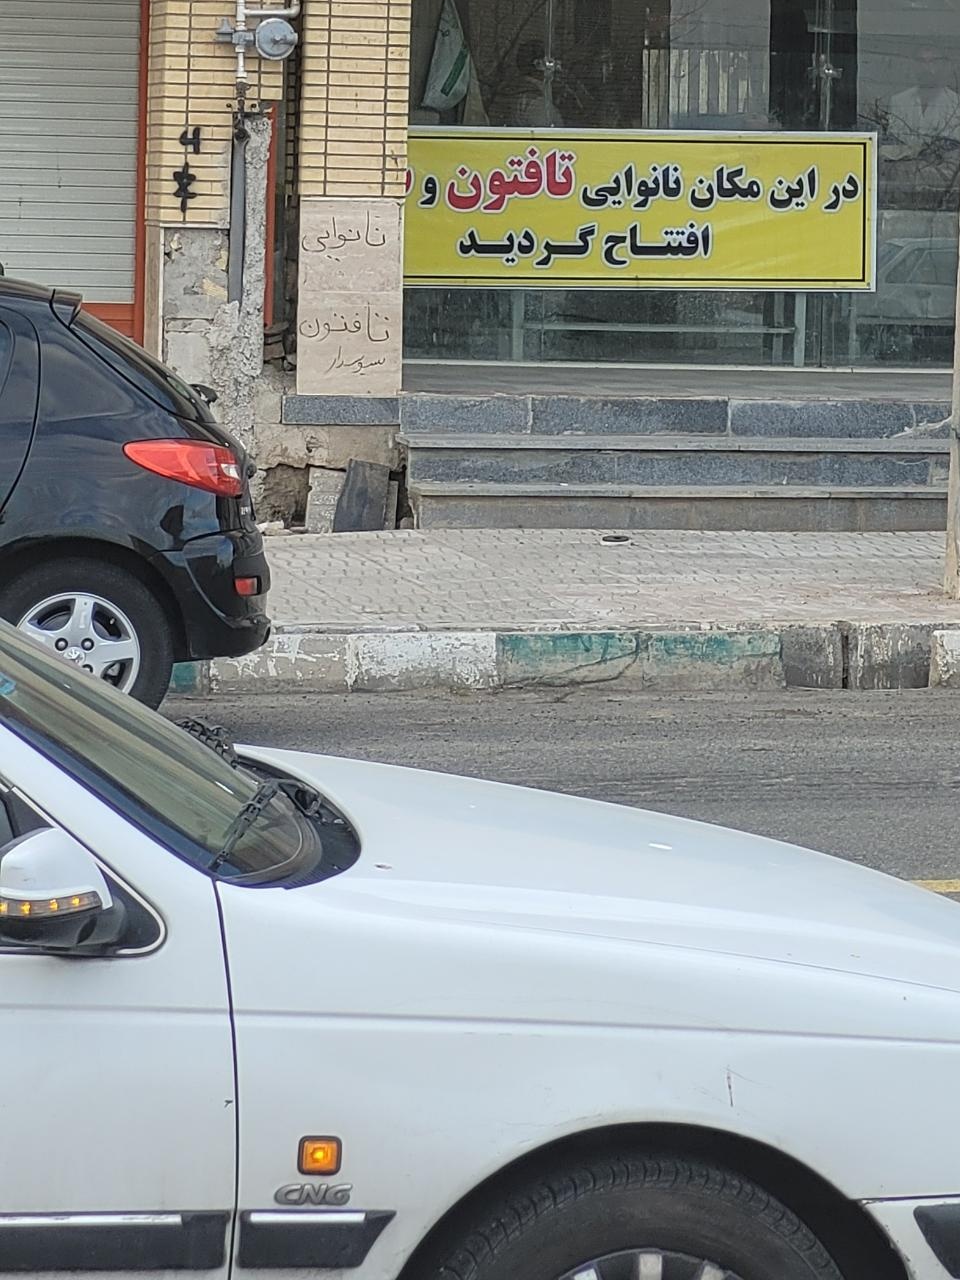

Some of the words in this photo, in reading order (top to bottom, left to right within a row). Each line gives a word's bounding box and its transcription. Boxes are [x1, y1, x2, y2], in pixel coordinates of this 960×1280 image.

[420, 176, 438, 205] و
[447, 147, 574, 210] تافتون
[582, 164, 682, 208] نانوایی
[690, 166, 761, 208] مکان
[769, 167, 816, 209] این
[823, 174, 859, 210] در
[301, 209, 386, 263] نانوایی
[459, 224, 597, 266] گردید
[603, 223, 709, 266] افتتاح
[274, 1183, 353, 1206] CNG
